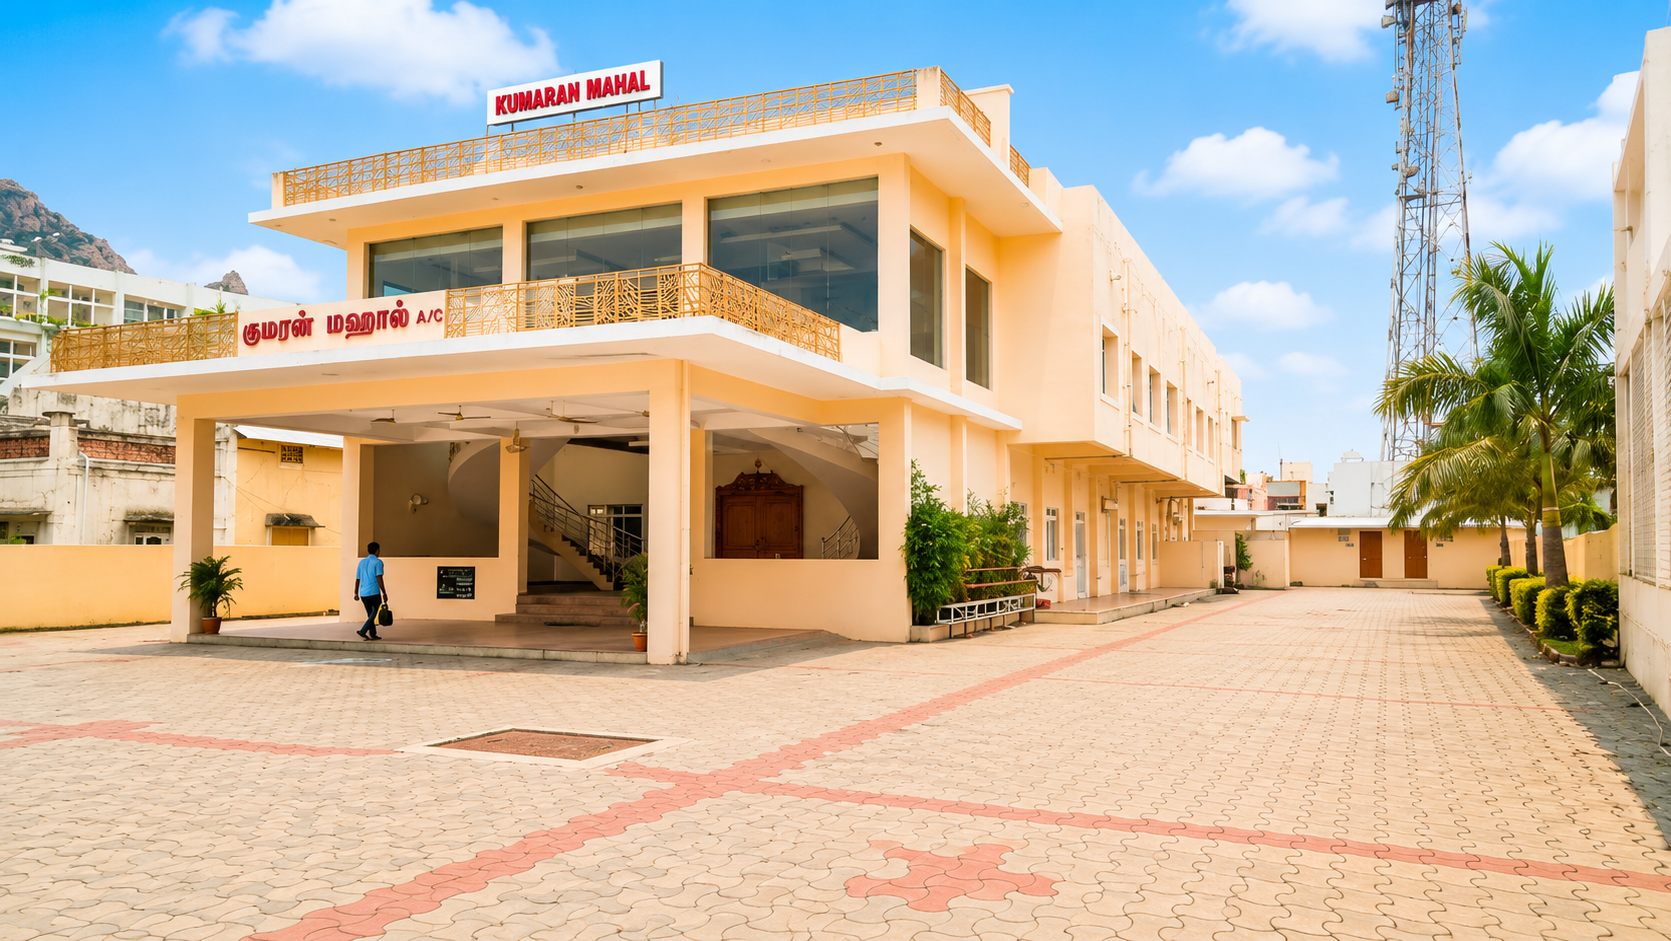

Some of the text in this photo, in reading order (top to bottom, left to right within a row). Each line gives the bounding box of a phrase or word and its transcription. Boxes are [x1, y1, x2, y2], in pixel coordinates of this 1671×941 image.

[495, 69, 651, 116] KUMARAN MAHAL
[243, 299, 444, 346] குமரன் மஹால் A/C
